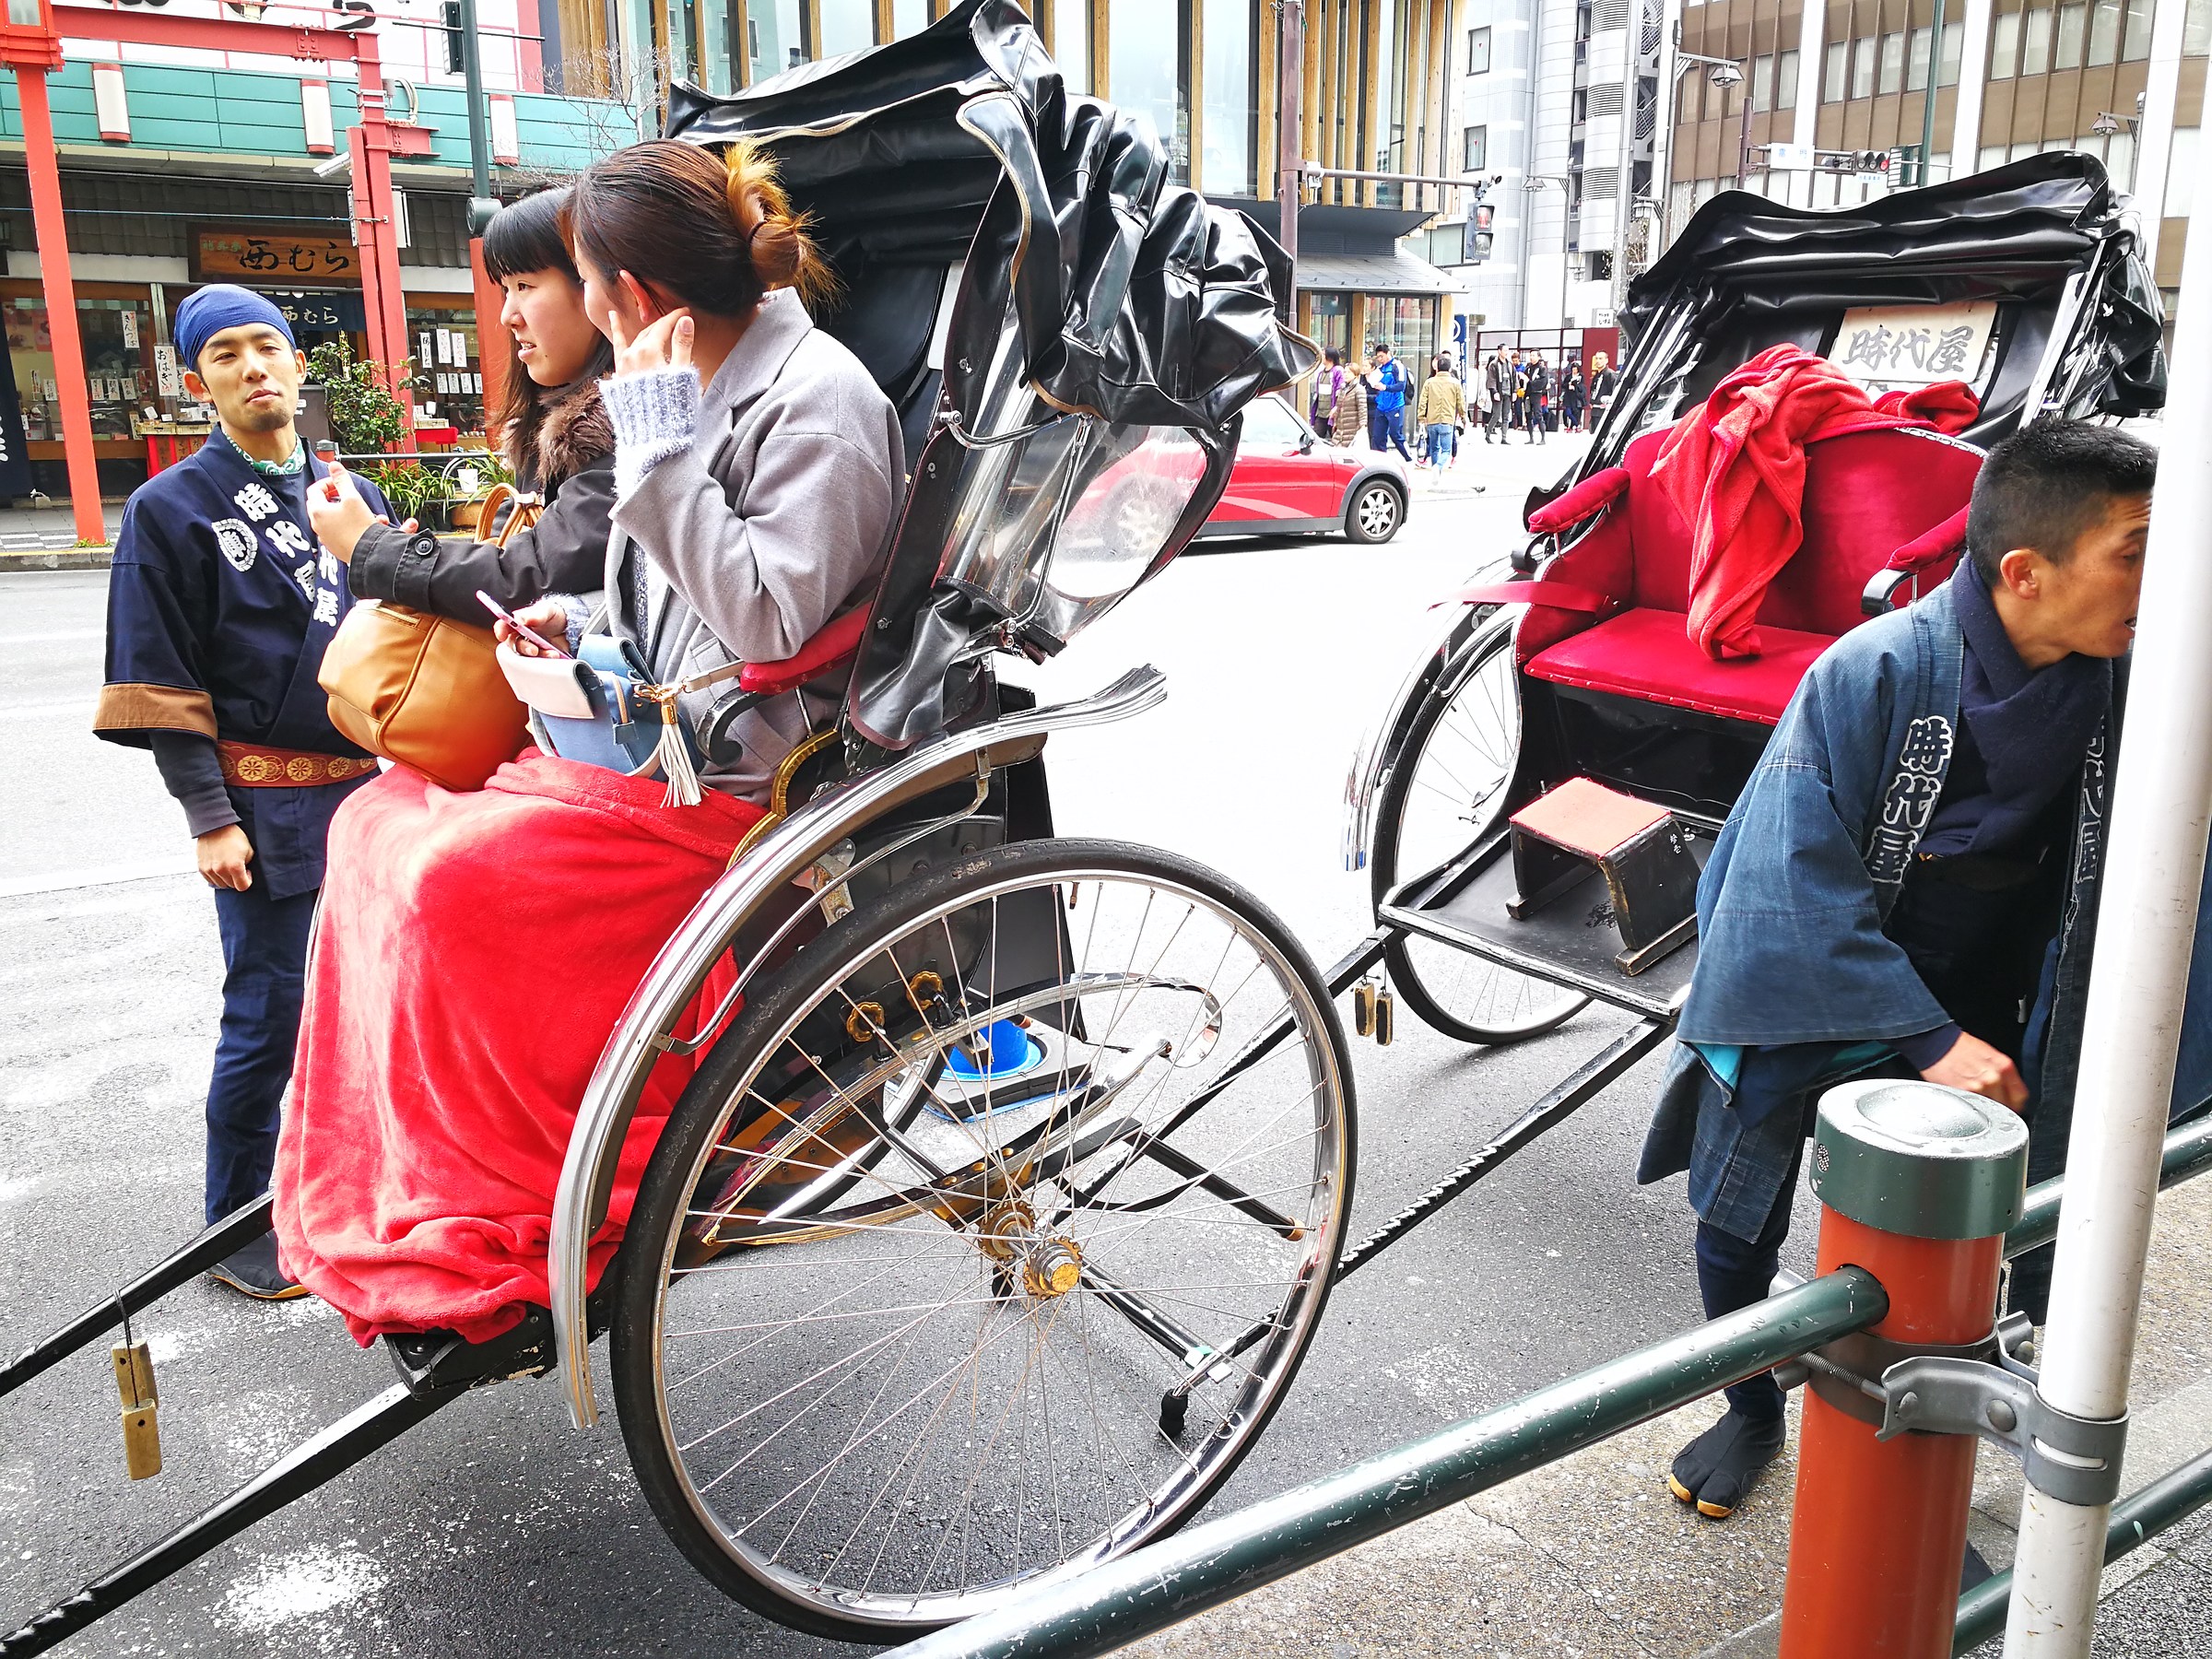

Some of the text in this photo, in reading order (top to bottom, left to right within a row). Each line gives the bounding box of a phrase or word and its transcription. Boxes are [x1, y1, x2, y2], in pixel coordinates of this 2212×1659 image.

[240, 238, 349, 275] 西むら
[1841, 324, 1974, 373] 時代屋
